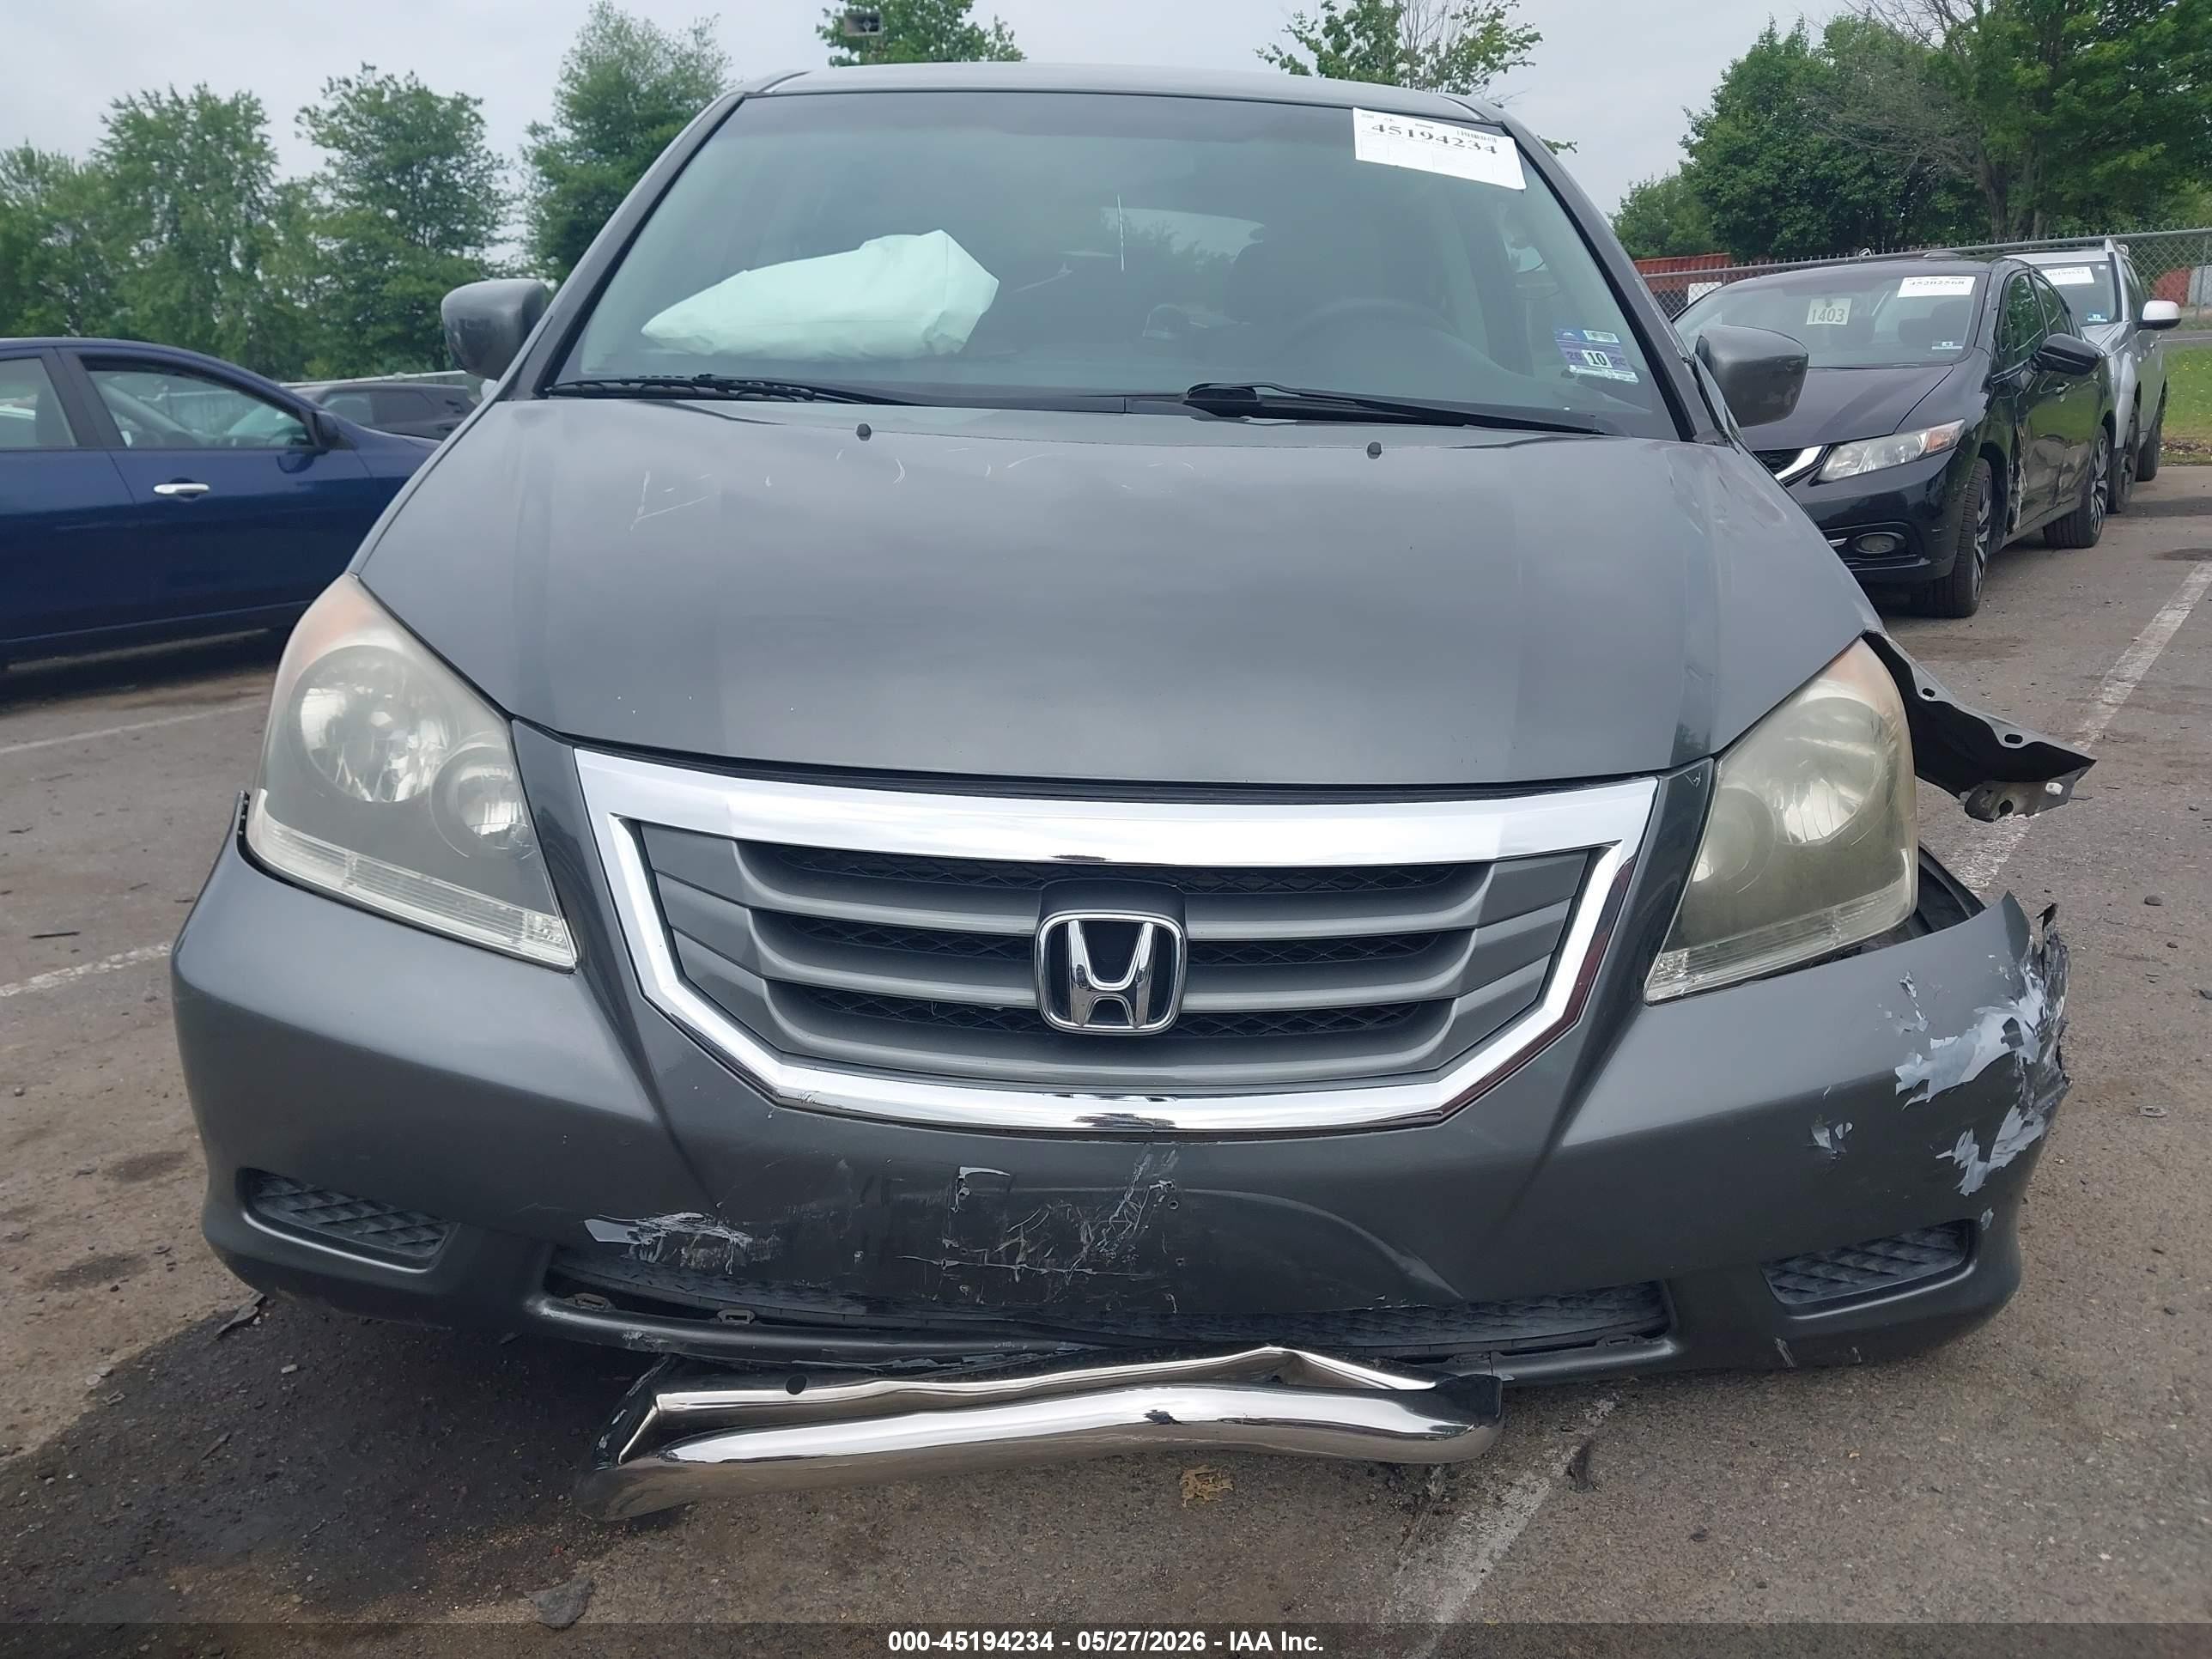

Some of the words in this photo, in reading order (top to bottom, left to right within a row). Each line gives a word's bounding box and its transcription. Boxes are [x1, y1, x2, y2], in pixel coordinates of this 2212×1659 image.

[1371, 124, 1498, 155] 45194234
[1812, 308, 1845, 323] 1403
[1587, 352, 1608, 366] 10
